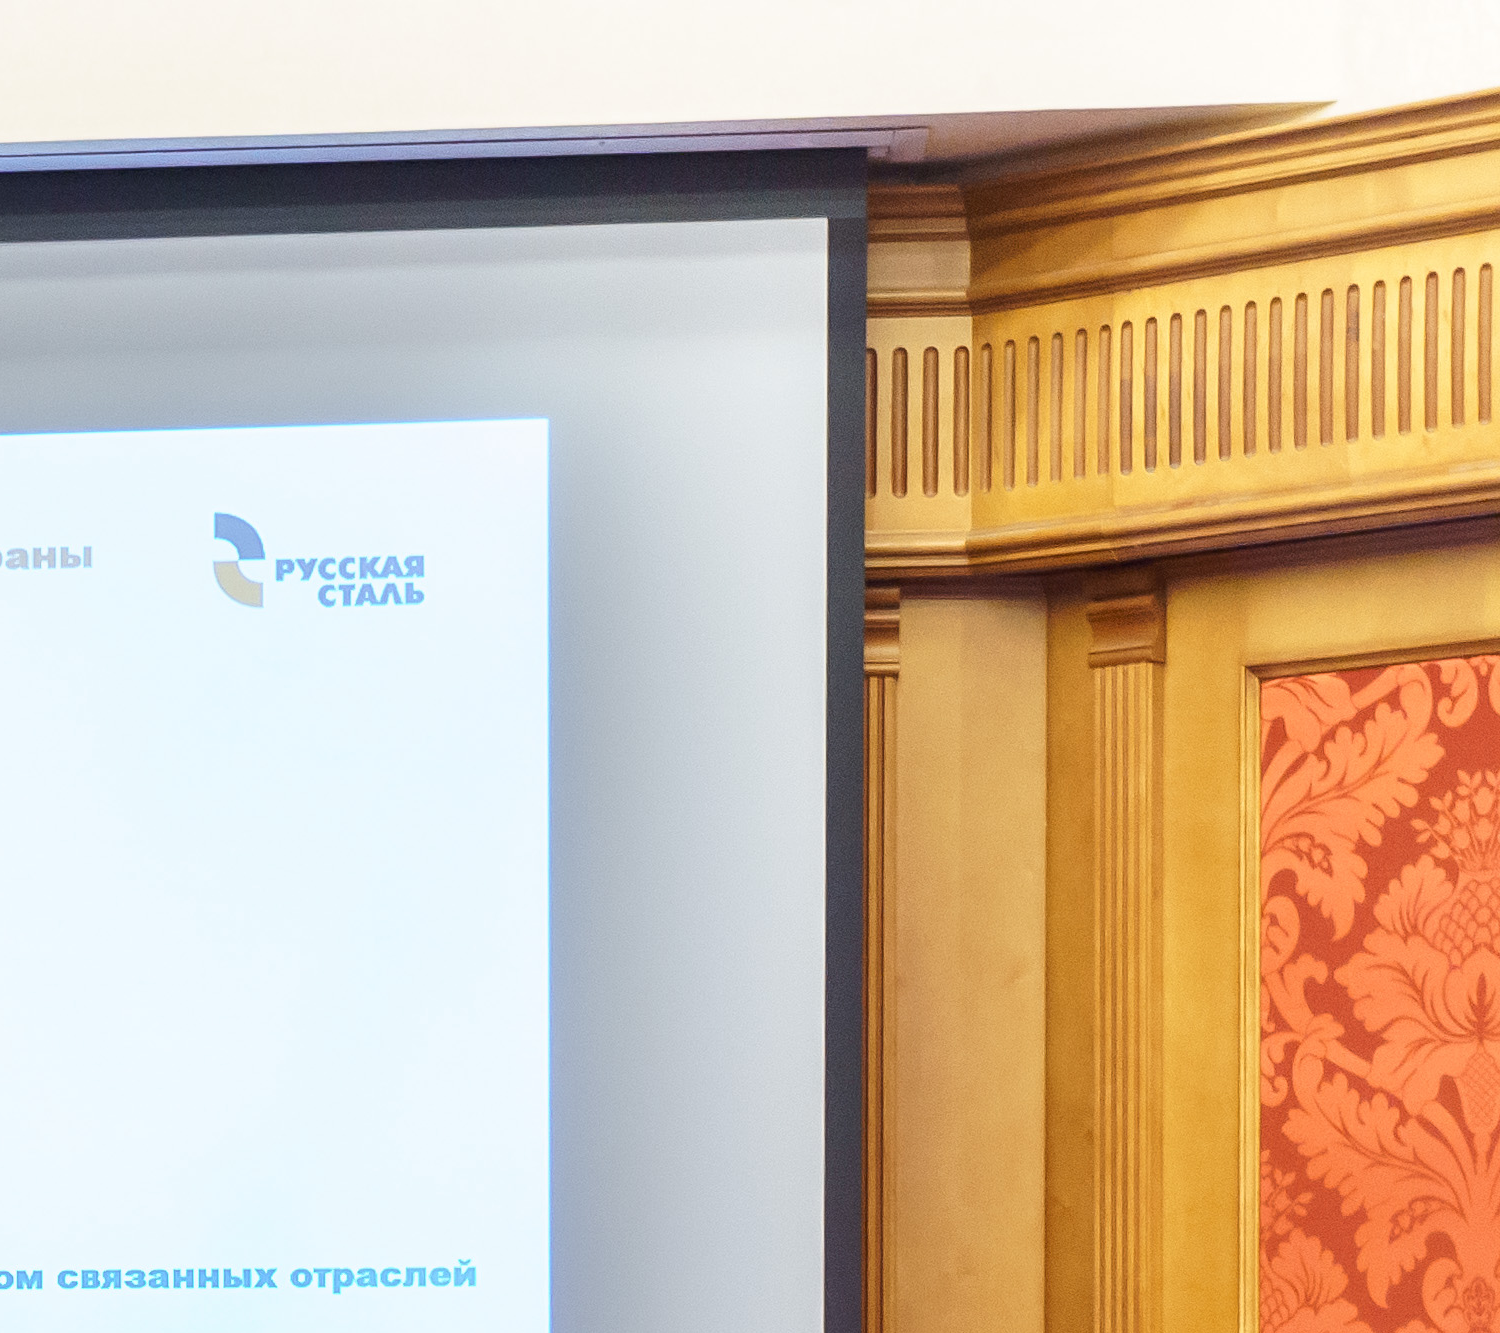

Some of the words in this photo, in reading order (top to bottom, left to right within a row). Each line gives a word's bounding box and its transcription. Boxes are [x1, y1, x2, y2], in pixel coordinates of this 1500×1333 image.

[274, 554, 425, 582] РУССКАЯ
[316, 581, 425, 608] СТАЛЬ
[57, 1267, 278, 1290] связанных
[289, 1258, 477, 1295] отраслей
